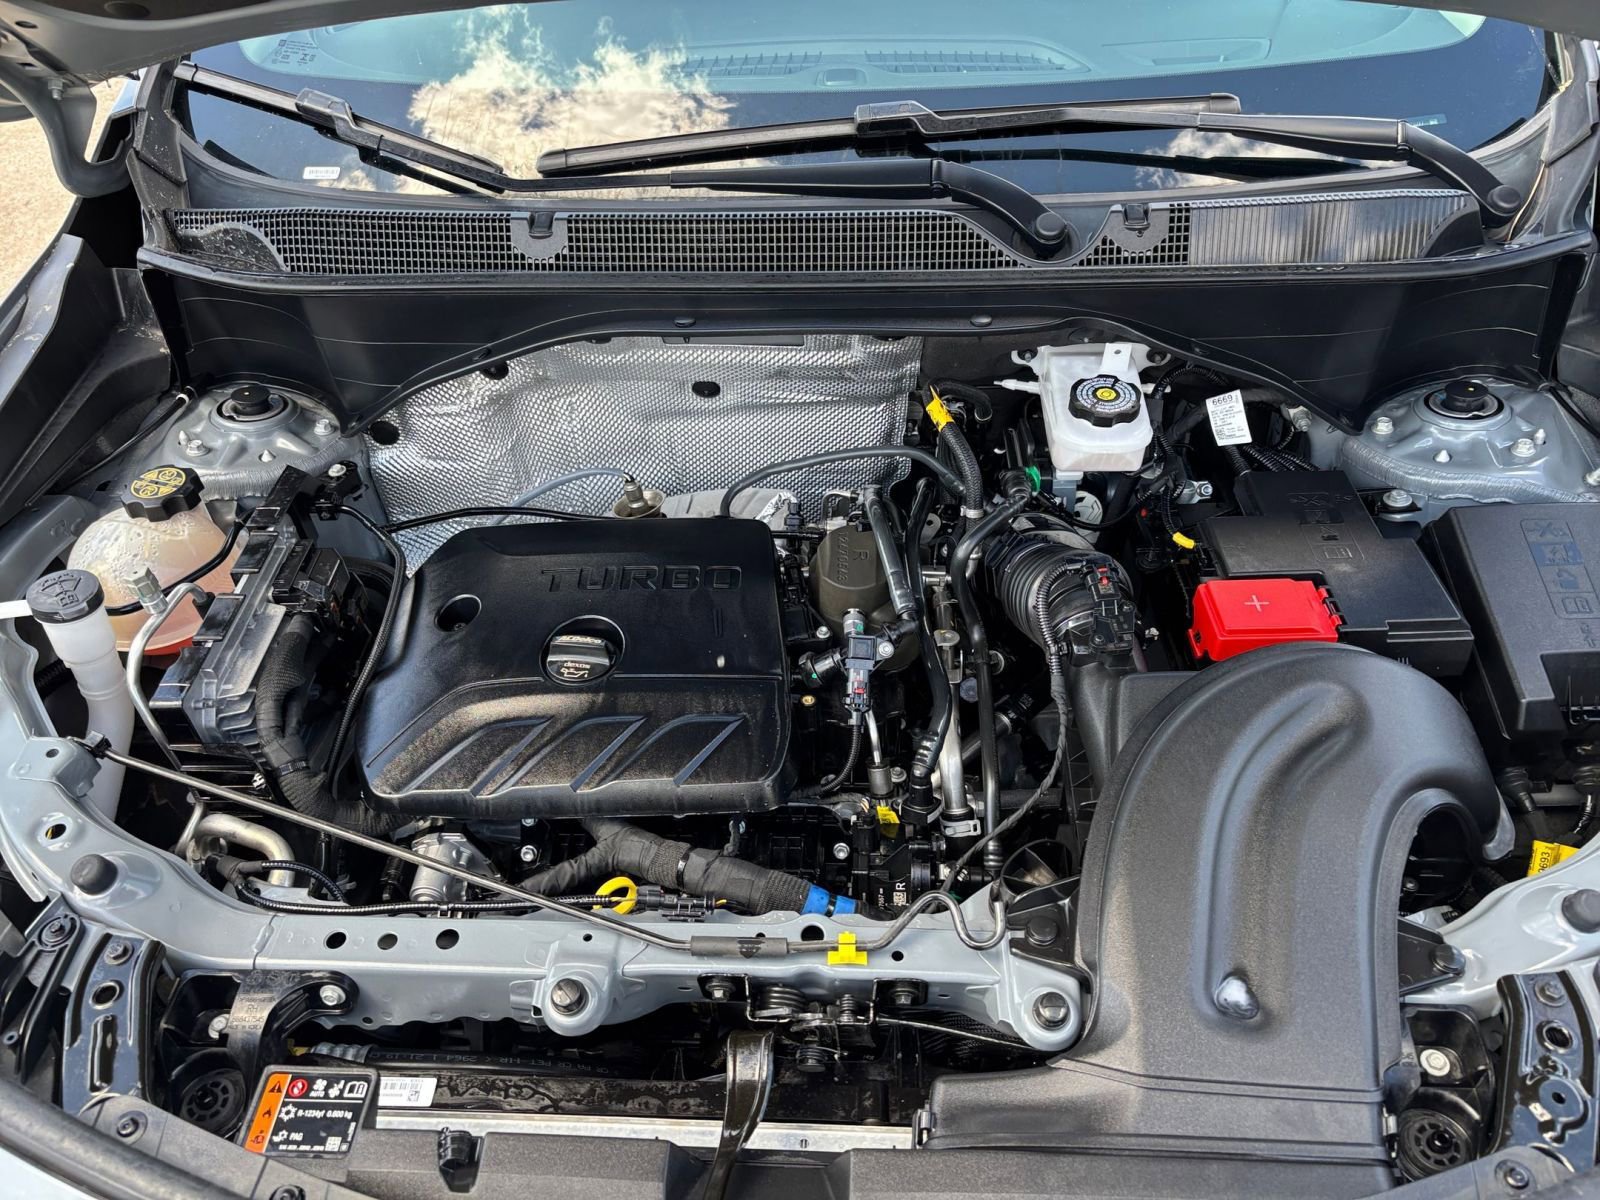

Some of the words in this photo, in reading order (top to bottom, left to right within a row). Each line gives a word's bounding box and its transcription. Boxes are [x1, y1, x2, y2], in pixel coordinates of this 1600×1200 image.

[1212, 394, 1233, 406] 6669
[853, 549, 869, 561] R
[541, 564, 742, 592] TURBO
[557, 634, 602, 644] ACDelco
[564, 661, 591, 669] dexos
[895, 882, 906, 890] R
[308, 1090, 325, 1098] AUTO
[297, 1108, 326, 1119] R-1234yf
[343, 1110, 353, 1120] kg
[289, 1132, 304, 1141] PAG
